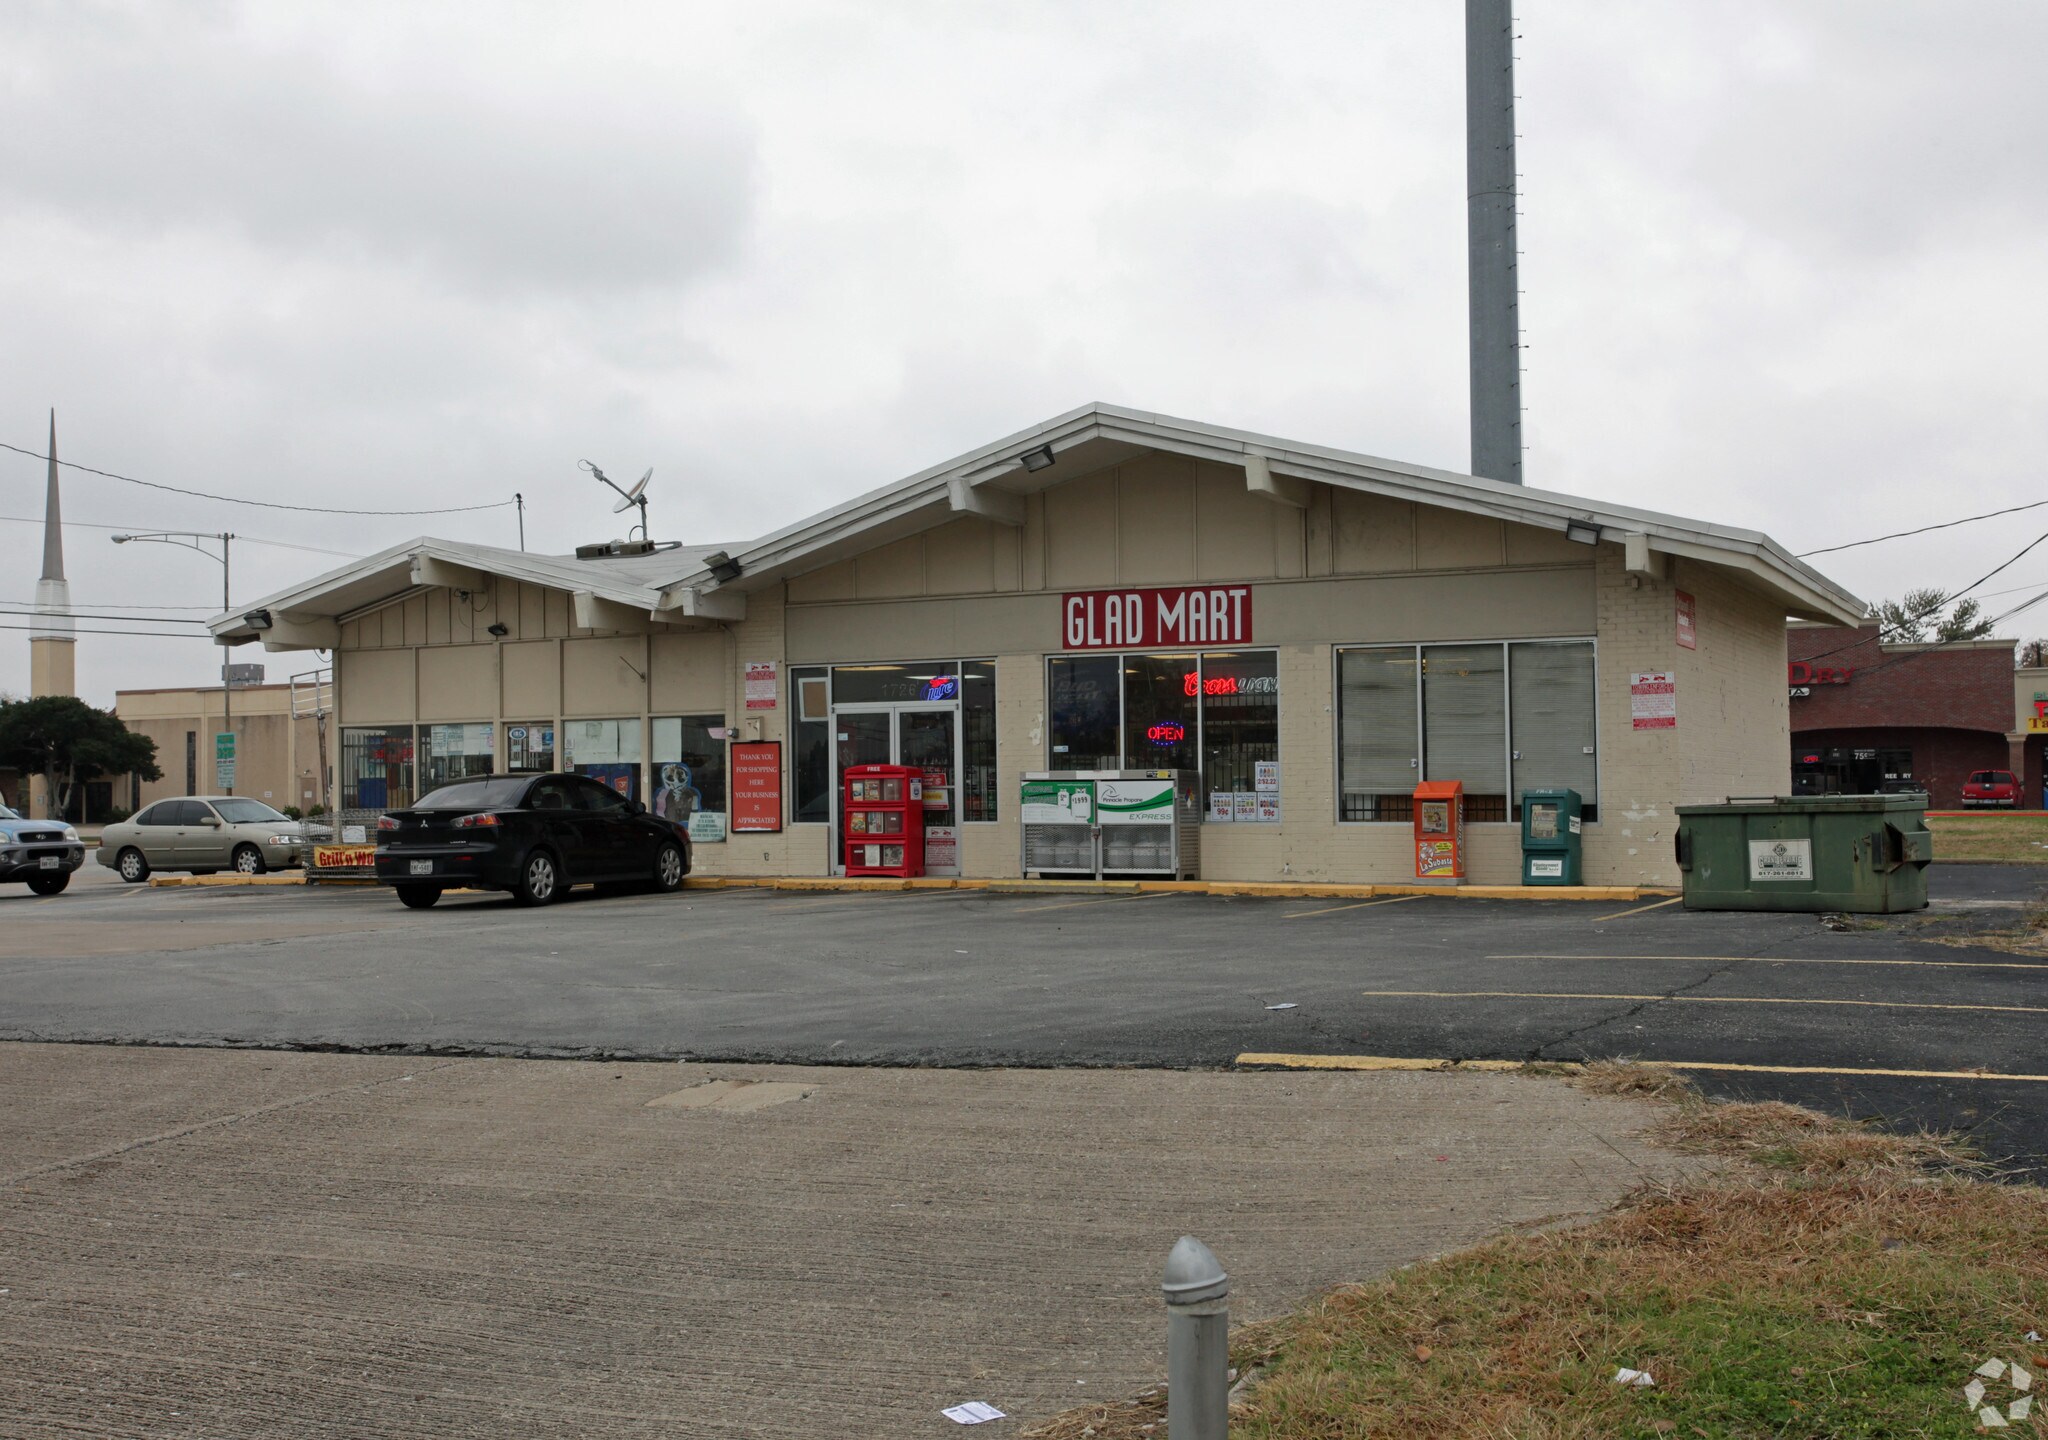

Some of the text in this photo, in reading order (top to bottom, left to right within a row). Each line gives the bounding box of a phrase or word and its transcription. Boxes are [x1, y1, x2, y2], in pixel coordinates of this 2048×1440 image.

[1067, 589, 1247, 646] GLAD MART
[881, 683, 917, 697] 1726
[1147, 727, 1185, 740] OPEN
[1420, 857, 1452, 872] La Subasta
